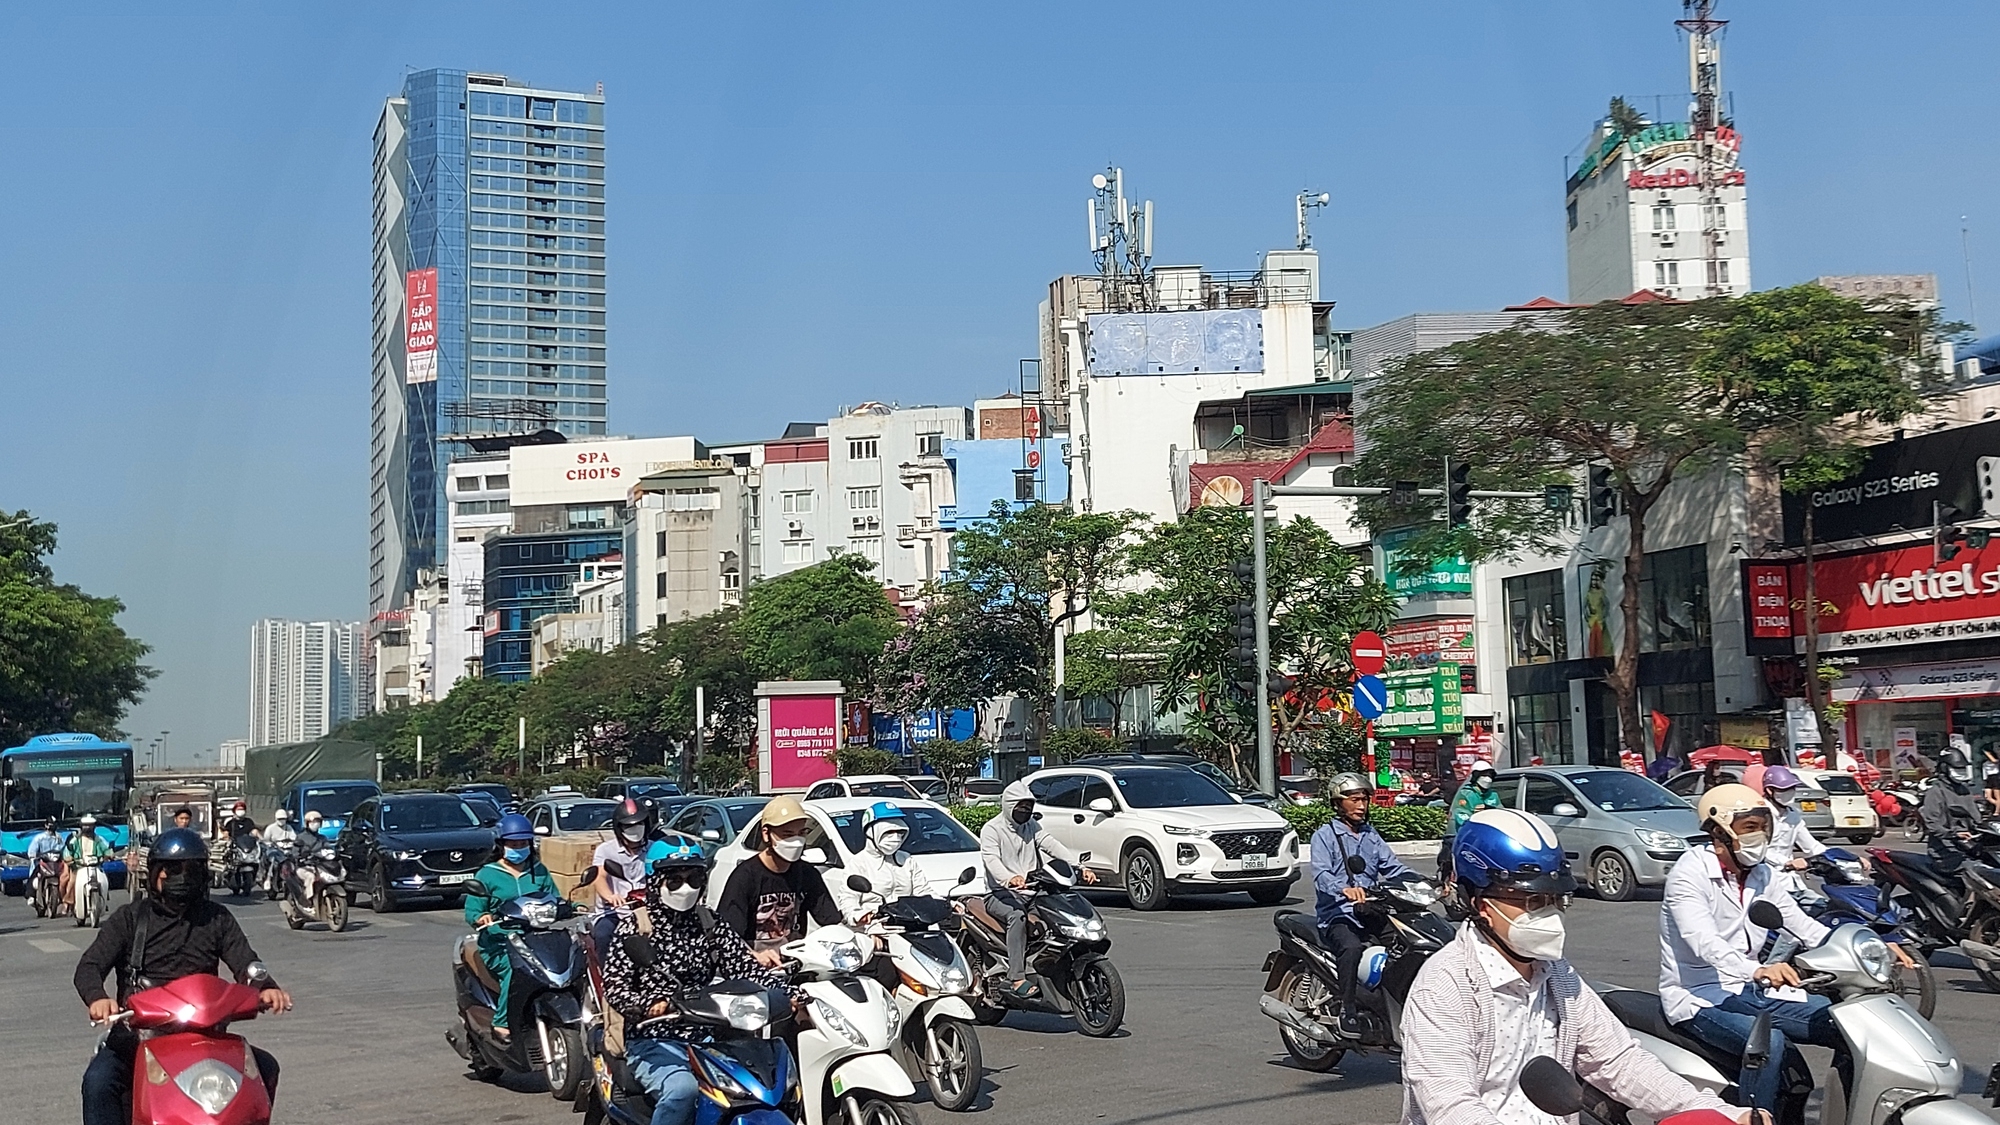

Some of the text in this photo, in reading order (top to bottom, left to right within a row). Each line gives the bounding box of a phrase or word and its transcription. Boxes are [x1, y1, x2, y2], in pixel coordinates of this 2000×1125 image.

[411, 319, 432, 333] BÀN
[409, 334, 434, 348] GIAO
[577, 452, 610, 463] SPA
[566, 467, 621, 481] CHOI'S
[1811, 471, 1940, 507] Galaxy S23 Series
[1757, 572, 1782, 586] BÁN
[1859, 563, 1980, 606] viettel
[1757, 593, 1784, 609] ĐIỆN
[1755, 616, 1790, 630] THOẠI
[1440, 664, 1458, 676] TRÁI
[1969, 670, 1998, 682] Series
[818, 725, 834, 736] CÁO
